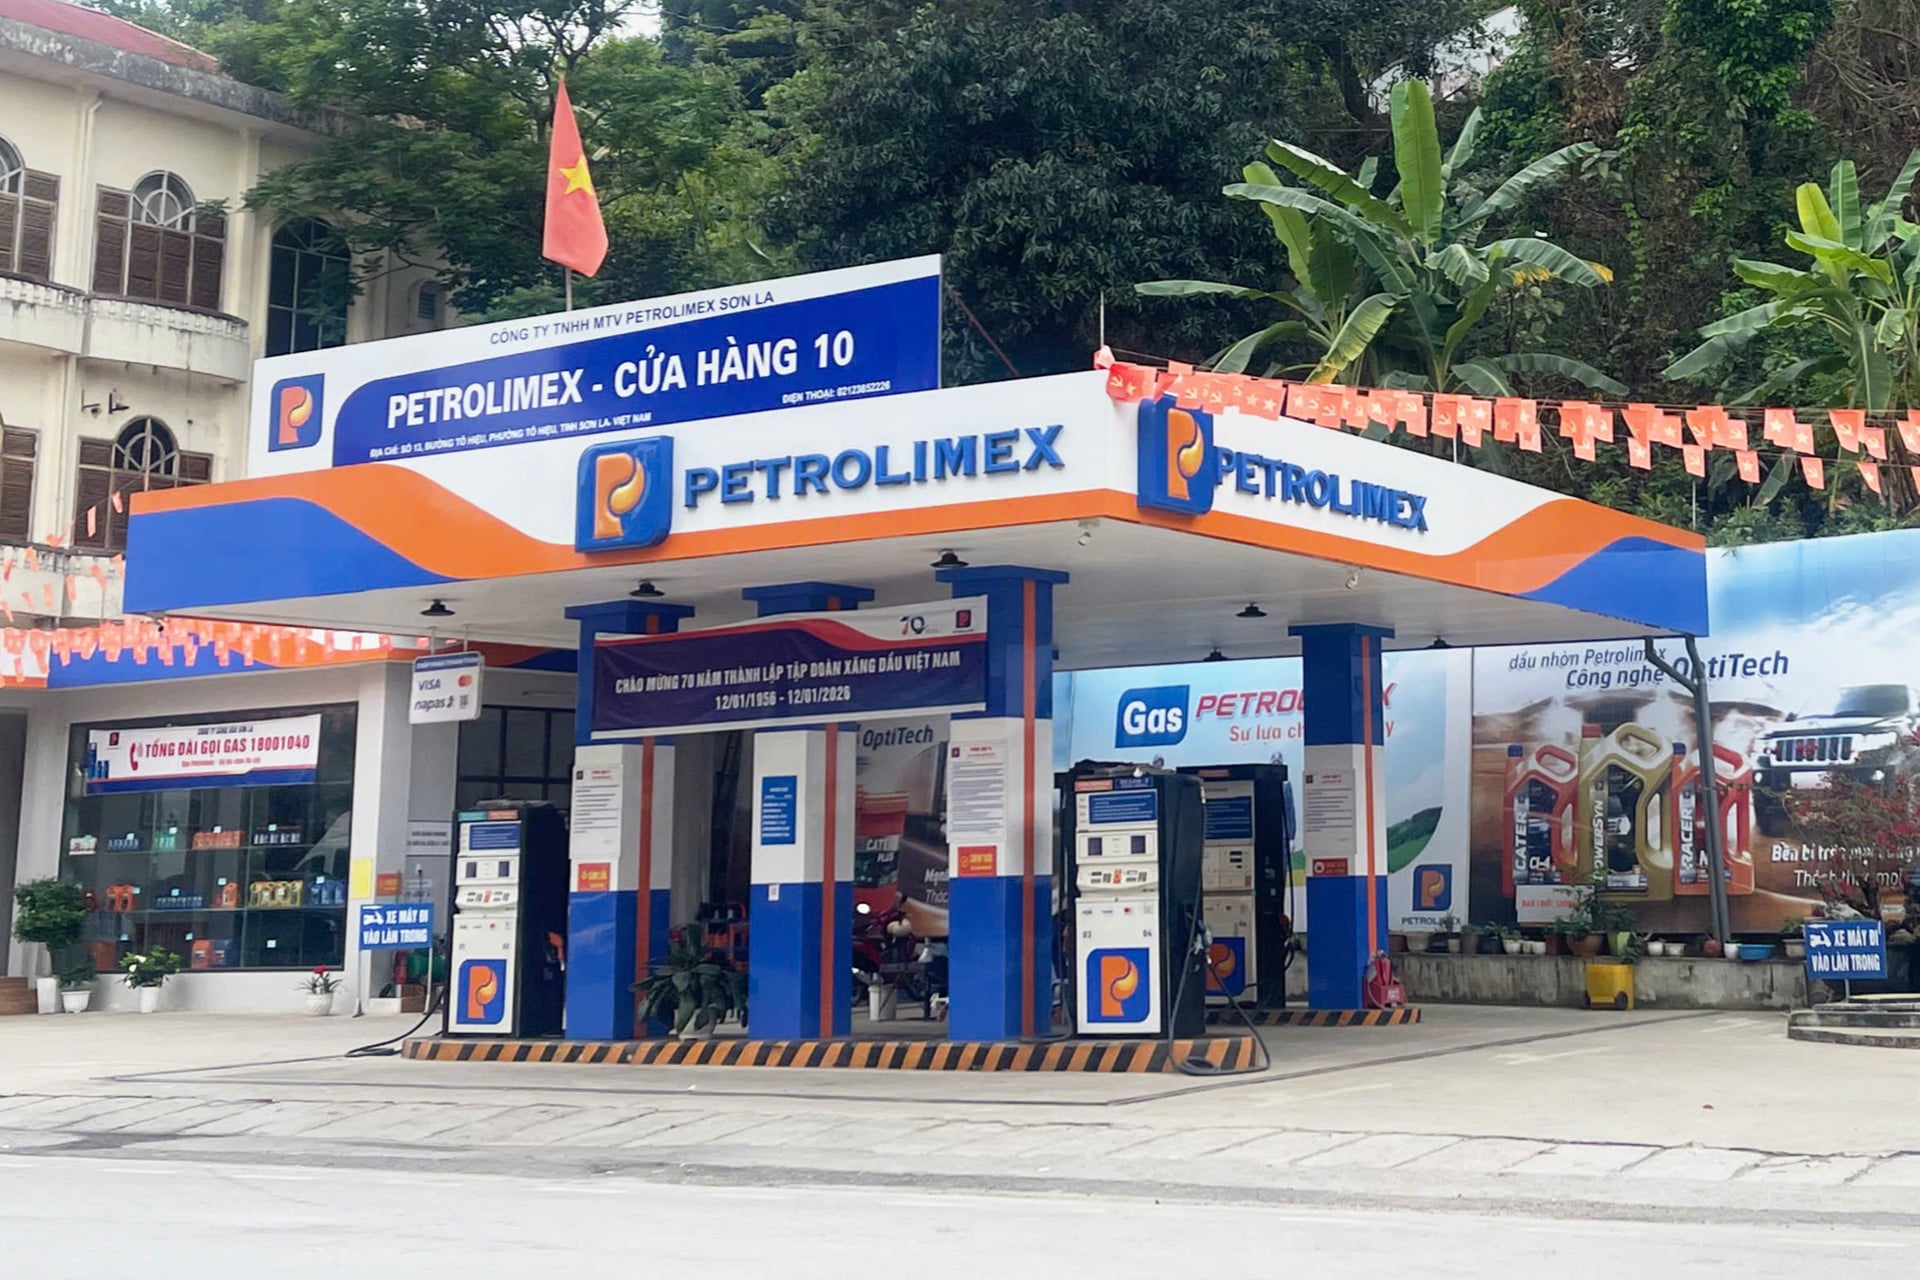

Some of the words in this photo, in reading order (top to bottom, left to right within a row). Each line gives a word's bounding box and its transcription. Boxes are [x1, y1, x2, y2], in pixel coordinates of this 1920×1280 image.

[490, 327, 529, 345] CÔNG
[533, 325, 550, 339] TY
[553, 320, 589, 336] TNHH
[593, 313, 622, 330] MTV
[626, 299, 716, 326] PETROLIMEX
[719, 295, 750, 310] SƠN
[755, 291, 774, 306] LA
[387, 368, 585, 429] PETROLIMEX
[613, 344, 688, 399] CỬA
[697, 335, 798, 388] HÀNG
[813, 330, 855, 368] 10
[684, 424, 1065, 508] PETROLIMEX
[1214, 446, 1429, 532] PETROLIMEX
[681, 673, 695, 689] 70
[696, 668, 722, 688] NĂM
[724, 665, 760, 686] THÀNH
[762, 660, 785, 685] LẬP
[787, 658, 808, 683] TẬP
[843, 655, 876, 676] XĂNG
[878, 651, 901, 672] DẦU
[904, 650, 931, 673] VIỆT
[932, 650, 960, 668] NAM
[1541, 652, 1579, 668] nhờn
[1584, 646, 1667, 665] Petrolimx
[418, 678, 441, 691] VISA
[1566, 668, 1611, 689] Công
[1617, 664, 1665, 688] nghệ
[414, 698, 445, 712] napas
[715, 690, 777, 711] 12/01/1956
[787, 685, 851, 705] 12/01/2026
[1123, 701, 1183, 735] Gas
[145, 738, 175, 759] TỔNG
[201, 739, 221, 758] GỌI
[224, 738, 247, 754] GAS
[250, 733, 310, 752] 18001040
[863, 725, 934, 750] OptiTech
[1230, 724, 1251, 746] Sự
[1256, 723, 1282, 745] lựa
[1515, 811, 1527, 871] CATER
[1680, 808, 1694, 871] RACER
[385, 909, 397, 924] XE
[398, 906, 418, 923] MÁY
[363, 928, 380, 945] VÀO
[381, 927, 398, 944] LÀN
[400, 928, 427, 943] TRONG
[1832, 929, 1846, 947] XE
[1847, 925, 1867, 947] MÁY
[1811, 951, 1829, 972] VÀO
[1831, 951, 1849, 972] LÀN
[1851, 953, 1881, 972] TRONG
